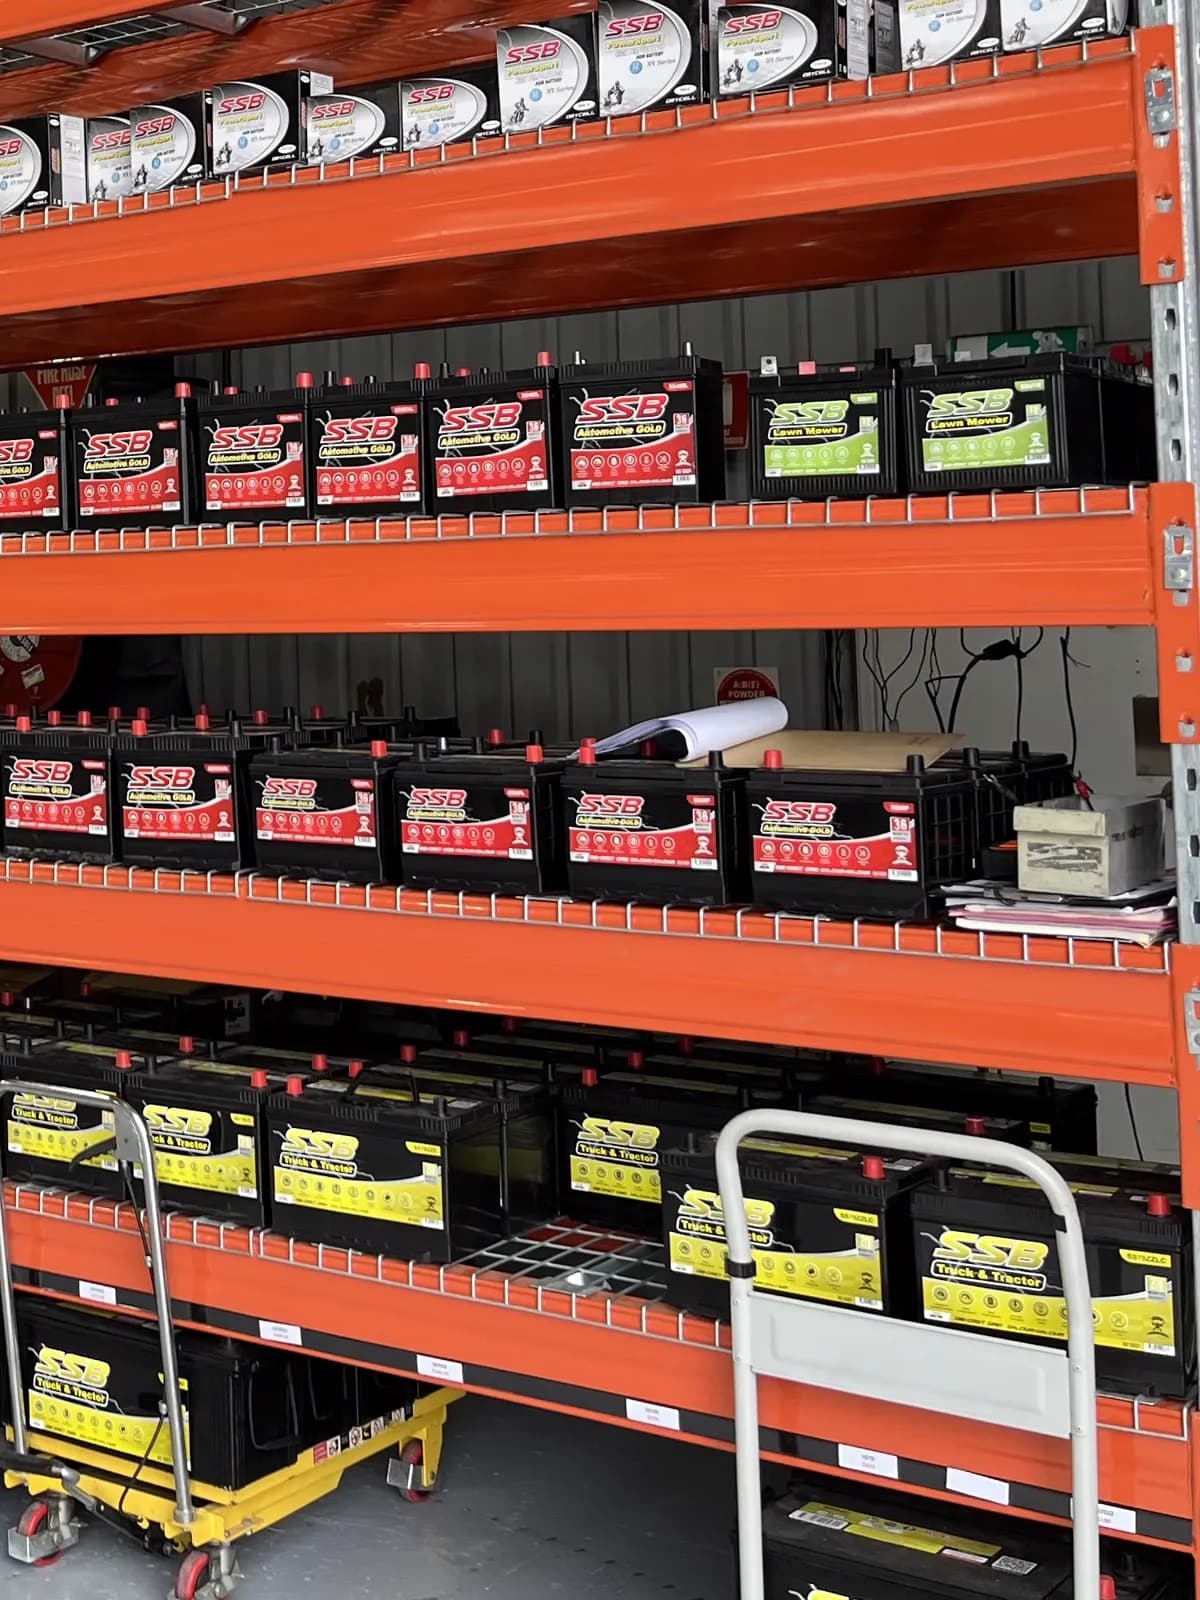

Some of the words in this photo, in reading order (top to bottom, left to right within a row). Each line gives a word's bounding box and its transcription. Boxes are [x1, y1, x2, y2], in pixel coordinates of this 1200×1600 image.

[606, 13, 663, 37] SSB
[723, 12, 782, 35] SSB
[505, 40, 562, 63] SSB
[218, 92, 267, 114] SSB
[409, 85, 455, 106] SSB
[312, 102, 356, 119] SSB
[135, 114, 176, 138] SSB
[575, 394, 669, 425] SSB
[770, 400, 849, 425] SSB
[927, 389, 1014, 417] SSB
[321, 416, 398, 442] SSB
[439, 402, 522, 434] SSB
[931, 419, 963, 431] Lawn
[967, 415, 1009, 427] Mower
[210, 424, 283, 451] SSB
[441, 435, 491, 447] Automotive
[577, 427, 633, 438] Automotive
[774, 428, 803, 438] Lawn
[806, 425, 844, 435] Mower
[86, 431, 152, 457] SSB
[321, 446, 369, 457] Automotive
[210, 453, 255, 464] Automotive
[12, 759, 72, 782] SSB
[129, 766, 195, 789] SSB
[263, 778, 317, 798] SSB
[408, 788, 467, 808] SSB
[577, 794, 644, 815] SSB
[762, 801, 836, 823] SSB
[15, 1106, 37, 1119] Truck
[47, 1113, 76, 1126] Tractor
[143, 1104, 212, 1136] SSB
[176, 1137, 208, 1151] Tractor
[578, 1116, 660, 1149] SSB
[282, 1128, 359, 1161] SSB
[580, 1143, 607, 1157] Truck
[619, 1150, 656, 1164] Tractor
[284, 1154, 309, 1167] Truck
[321, 1160, 354, 1176] Tractor
[681, 1220, 712, 1234] Truck
[933, 1231, 1049, 1270] SSB
[937, 1263, 974, 1279] Truck
[977, 1270, 988, 1281] &
[991, 1270, 1041, 1288] Tractor
[35, 1348, 110, 1388] SSB
[36, 1376, 62, 1393] Truck
[73, 1388, 106, 1404] Tractor
